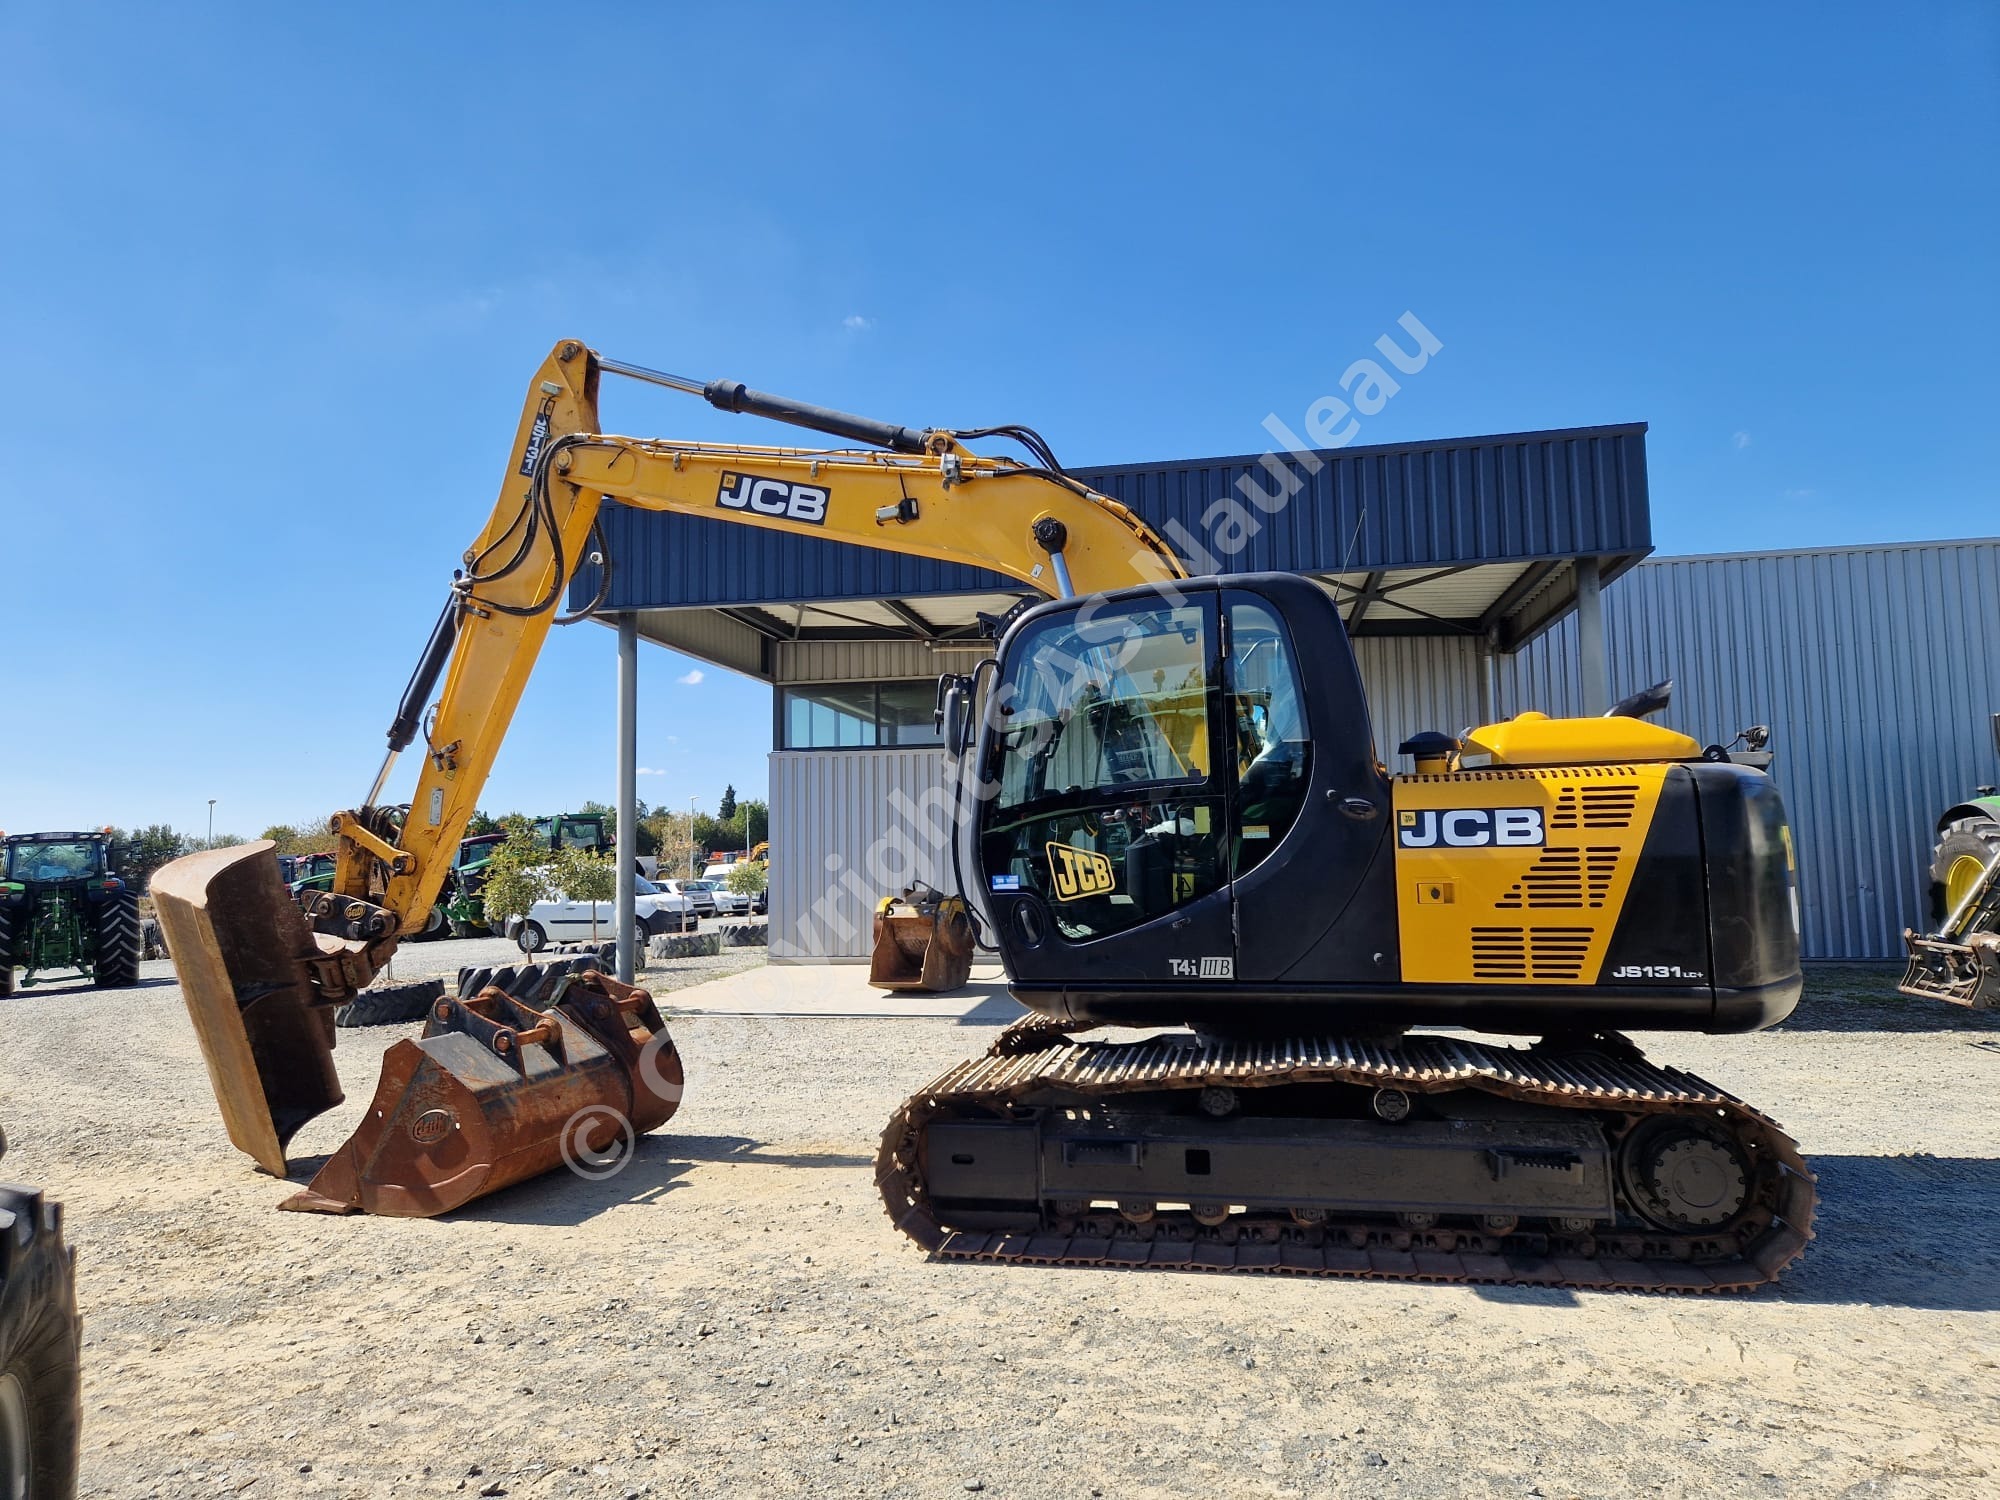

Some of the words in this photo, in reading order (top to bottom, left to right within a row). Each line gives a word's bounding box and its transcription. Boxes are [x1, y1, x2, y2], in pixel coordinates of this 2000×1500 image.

[525, 419, 547, 470] JS131
[720, 477, 826, 521] JCB
[1400, 809, 1544, 847] JCB
[1057, 848, 1111, 895] JCB
[1168, 958, 1199, 976] T4i
[1612, 966, 1681, 978] JS131
